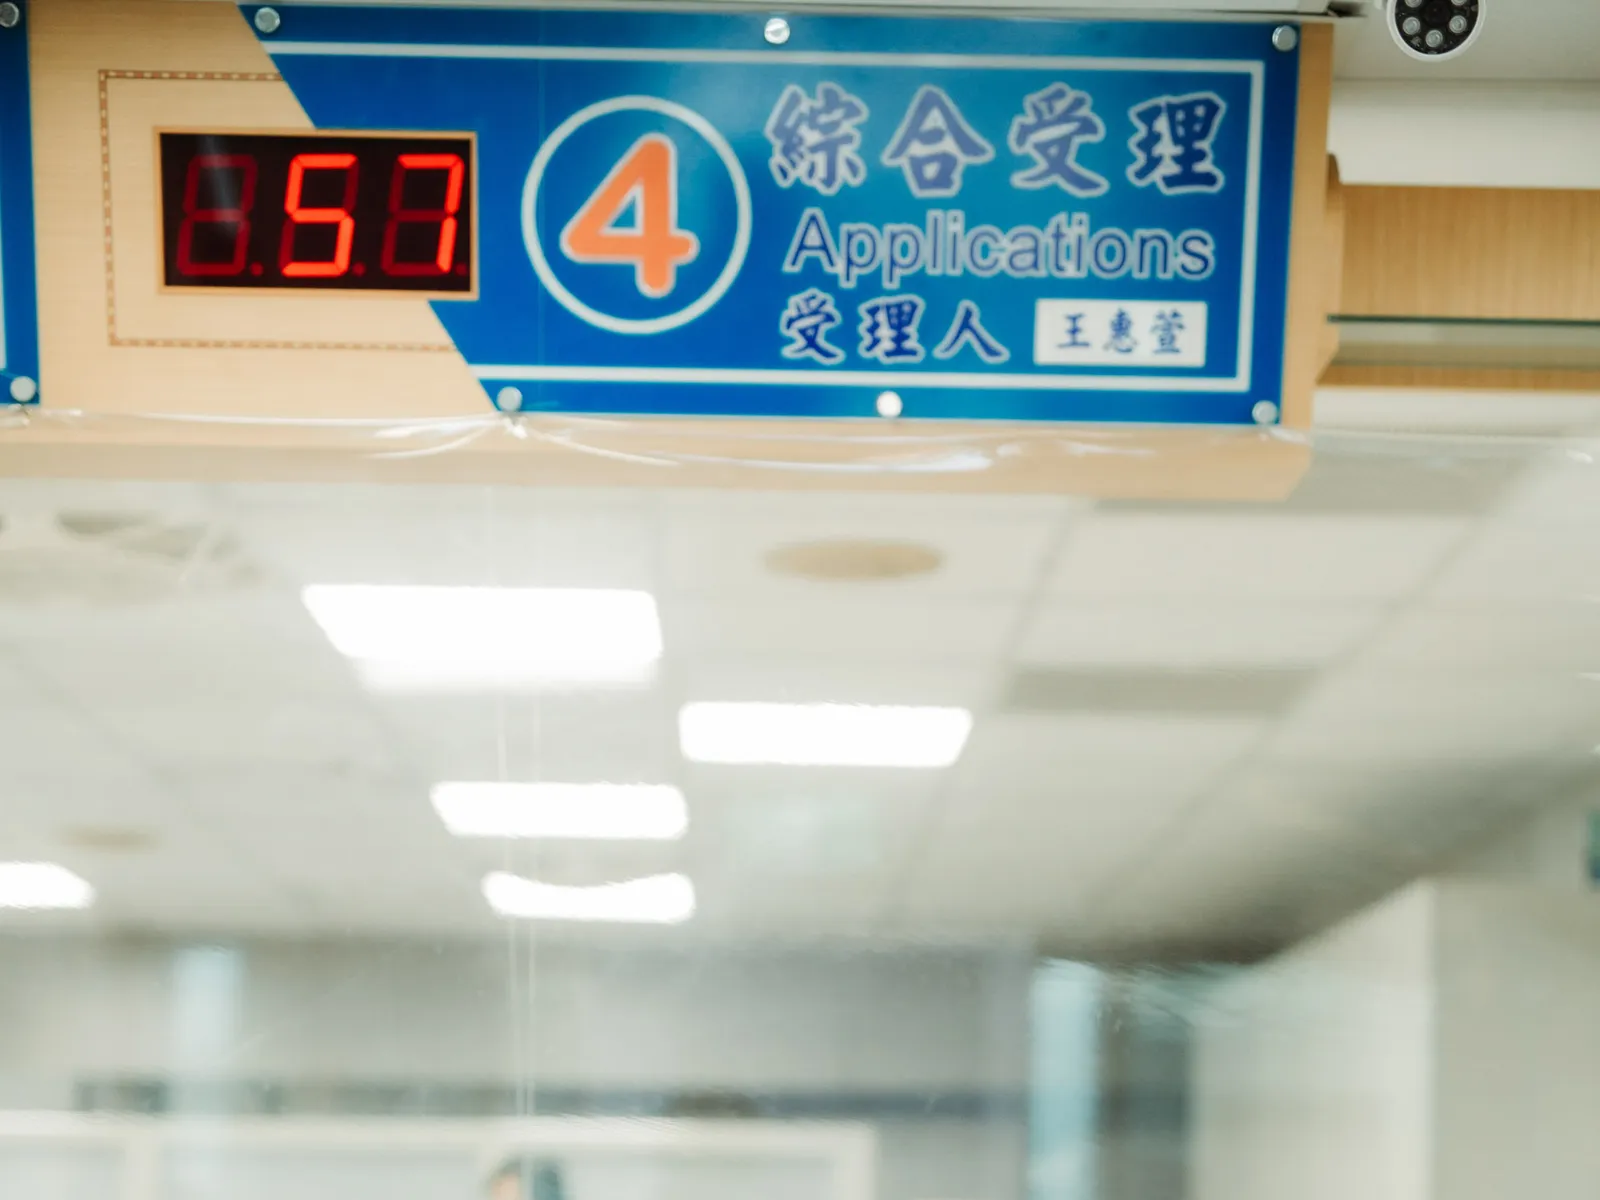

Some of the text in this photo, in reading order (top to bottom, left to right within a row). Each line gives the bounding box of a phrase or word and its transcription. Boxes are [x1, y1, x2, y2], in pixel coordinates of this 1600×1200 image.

[764, 81, 1227, 198] 綜合受理
[280, 152, 466, 278] 57
[559, 131, 699, 298] 4
[783, 206, 1216, 289] Applications
[780, 287, 1010, 366] 受理人
